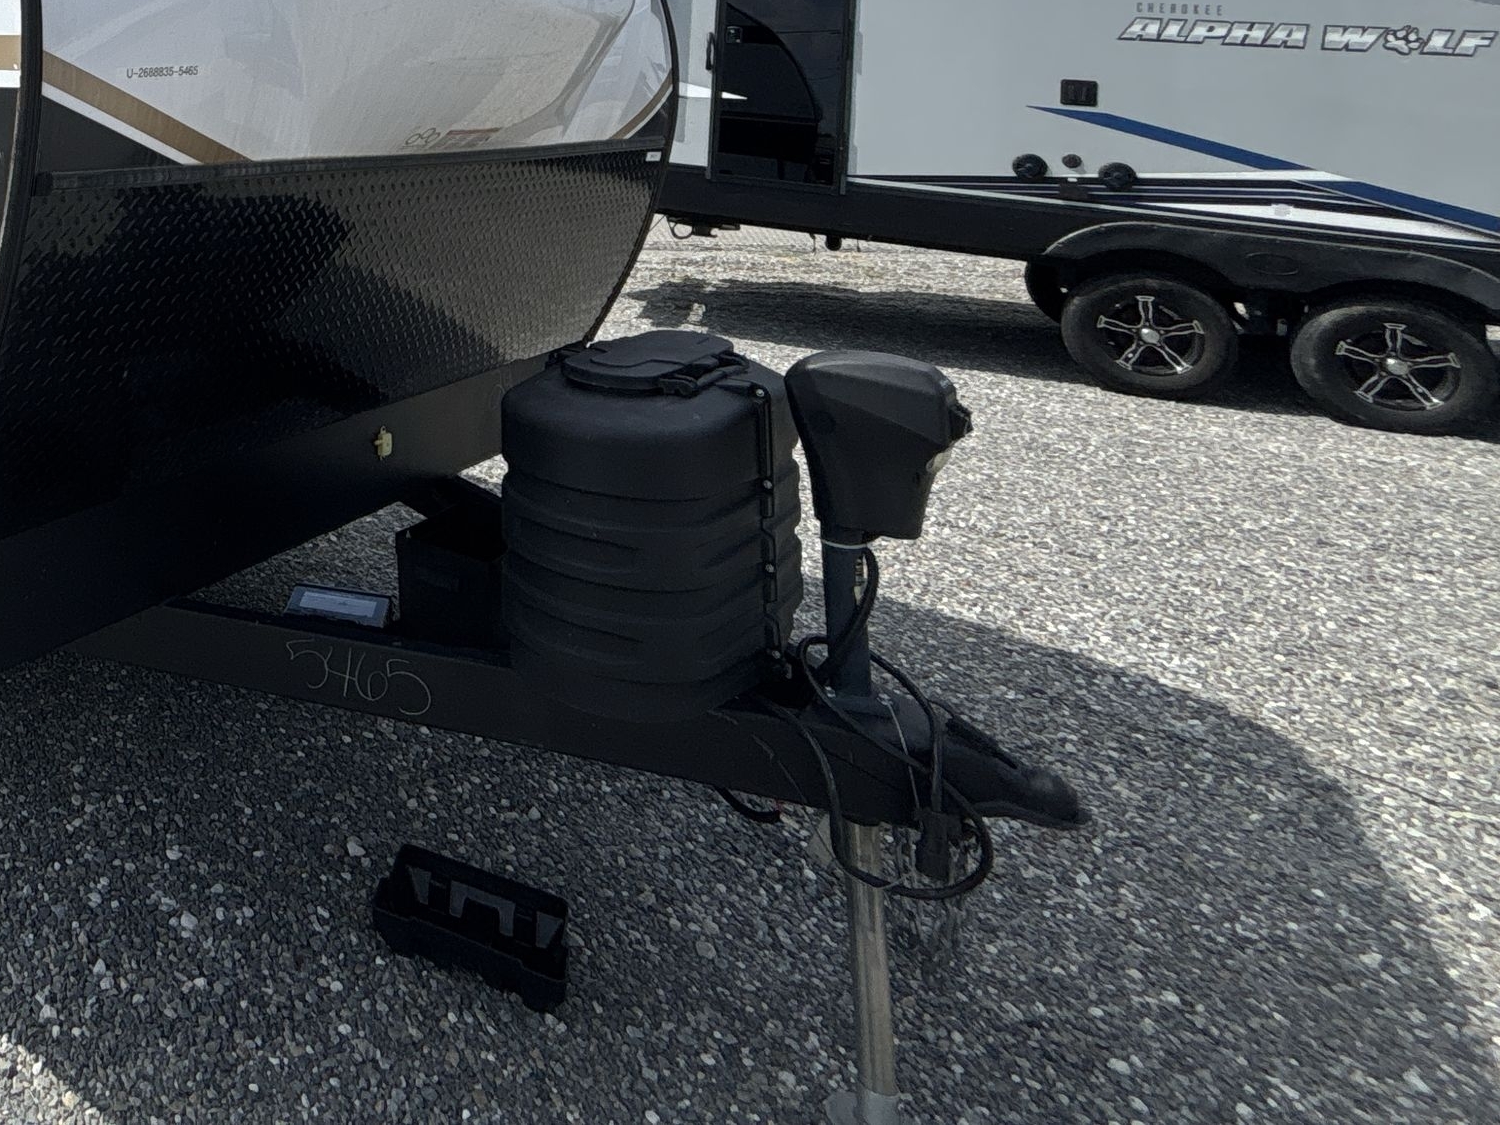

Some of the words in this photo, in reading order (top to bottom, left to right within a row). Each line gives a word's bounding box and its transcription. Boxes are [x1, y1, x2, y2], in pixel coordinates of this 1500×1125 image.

[1136, 1, 1223, 17] CHEROKEE
[1117, 16, 1311, 50] ALPHA
[286, 638, 432, 716] 5465
